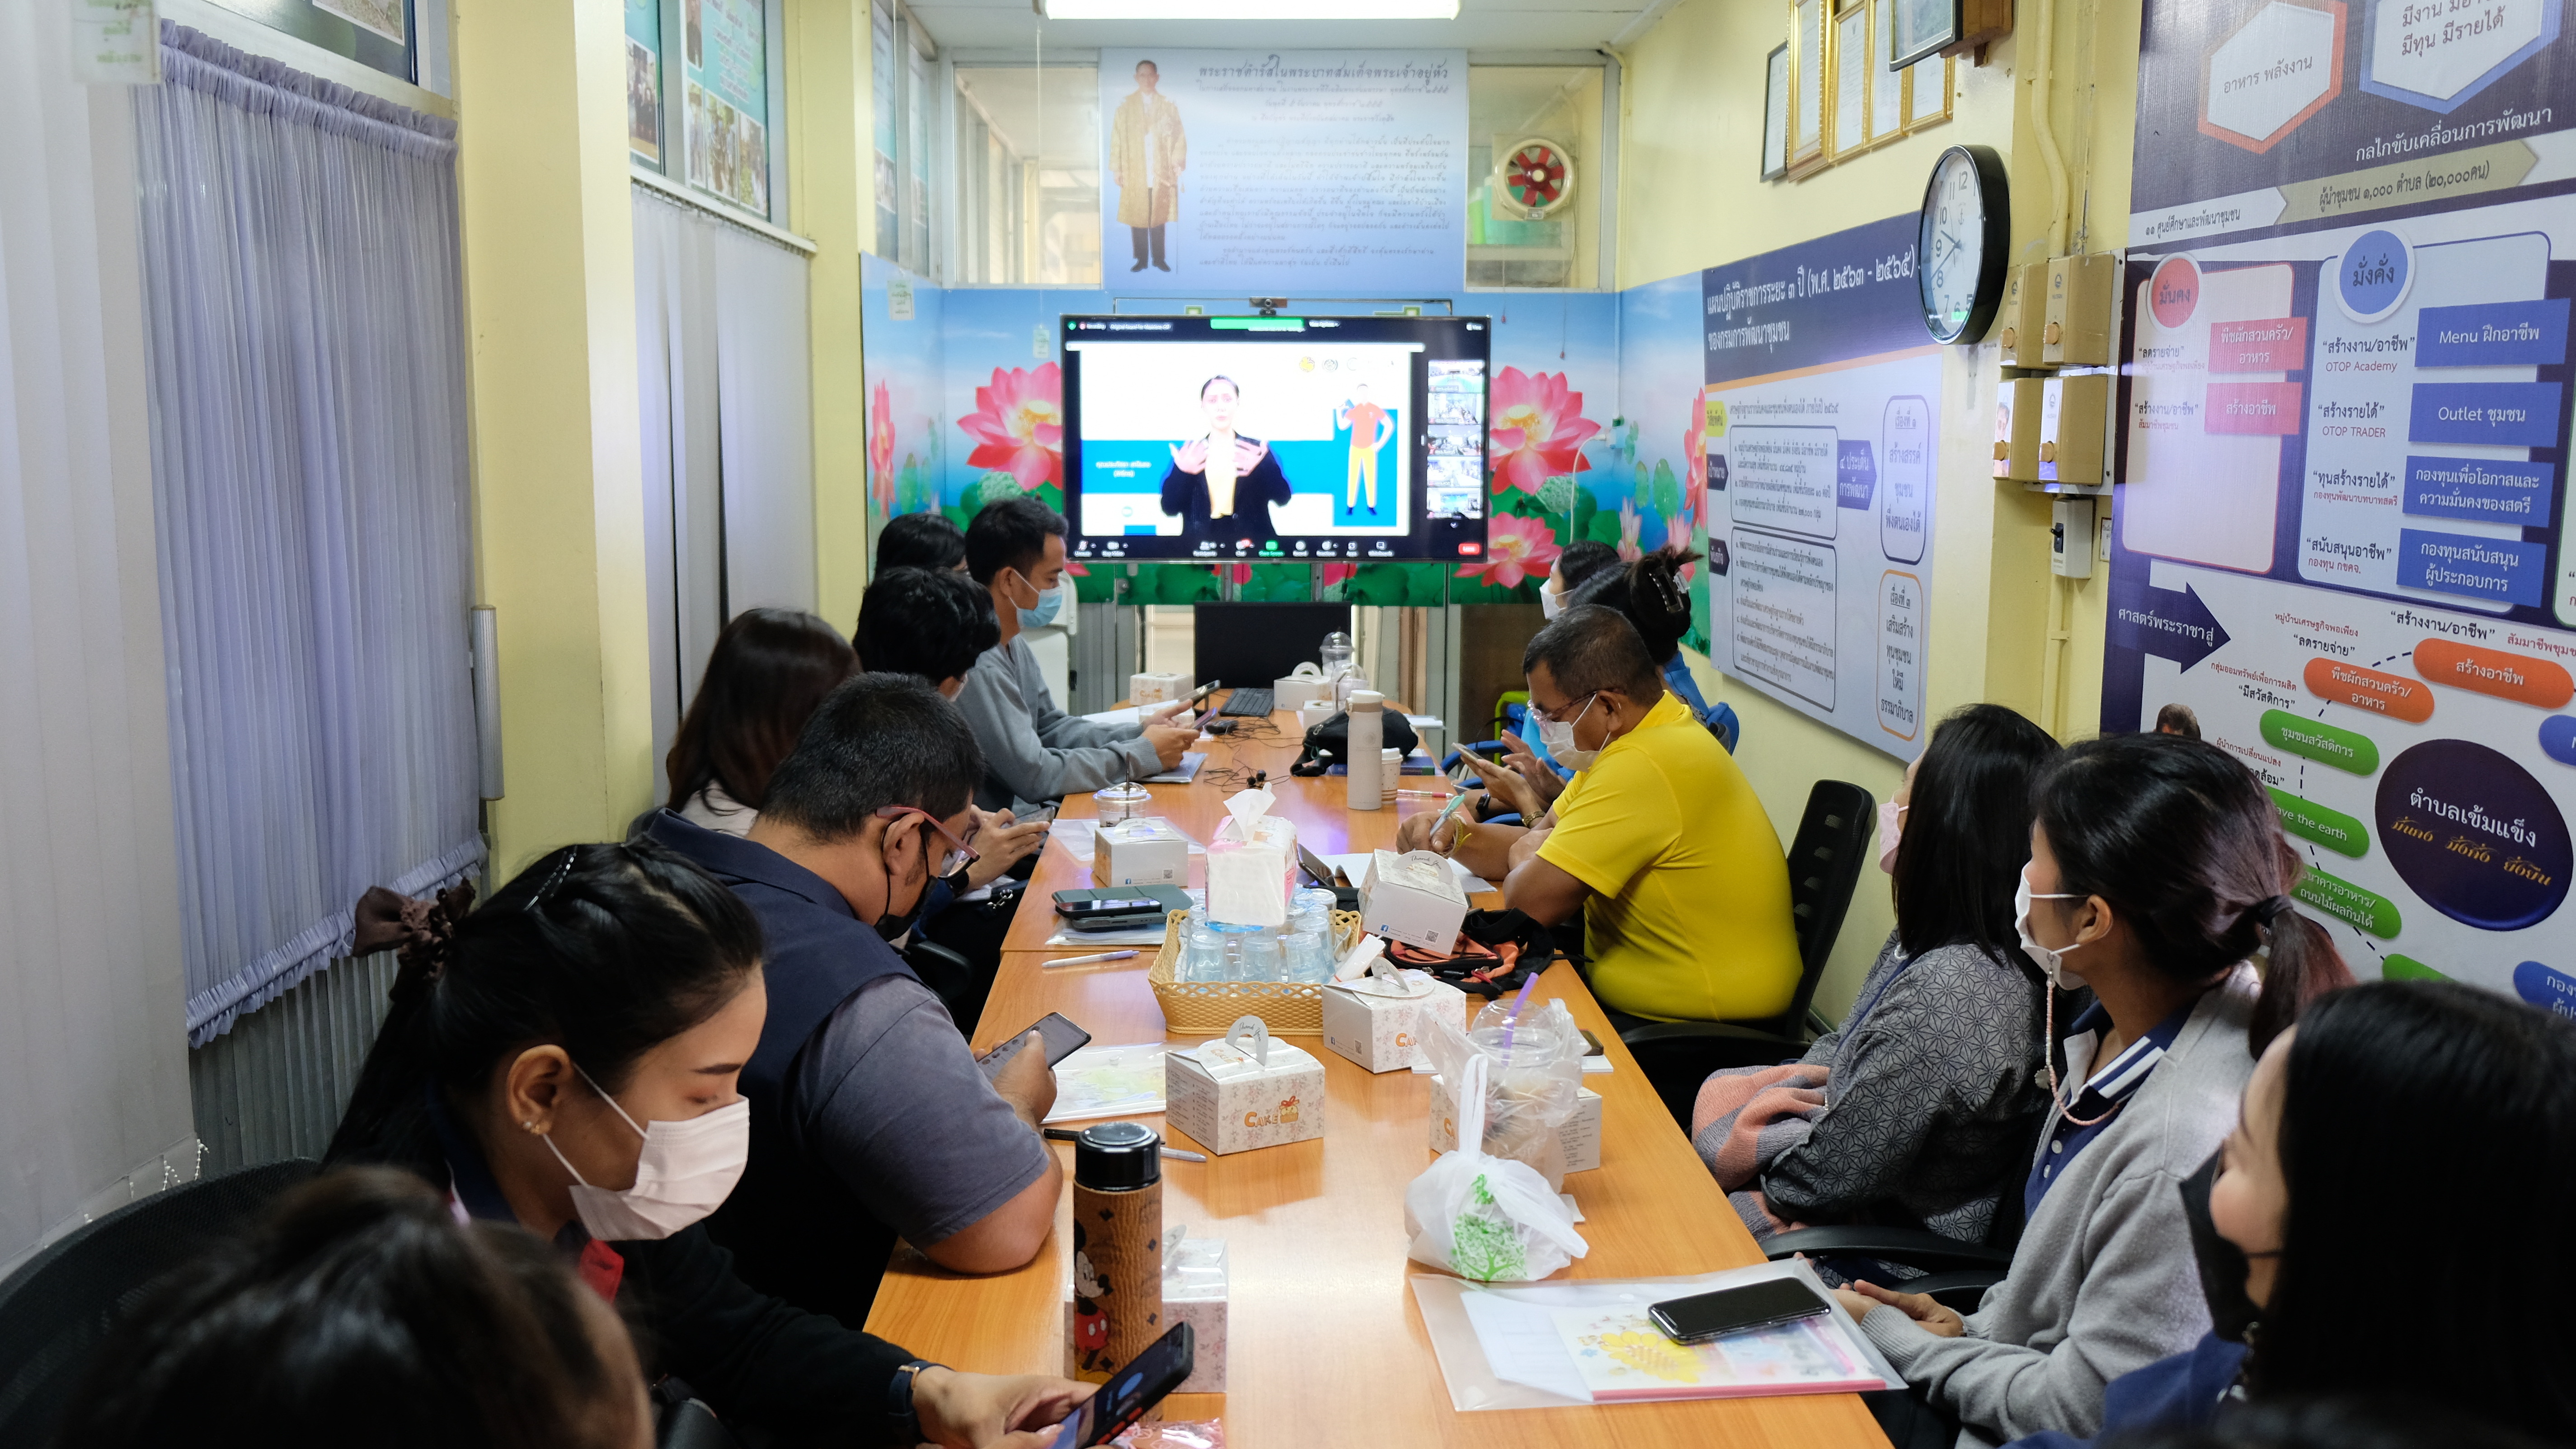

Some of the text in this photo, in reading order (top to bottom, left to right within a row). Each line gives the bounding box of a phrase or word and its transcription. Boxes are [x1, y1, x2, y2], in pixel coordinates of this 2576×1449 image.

[2402, 3, 2442, 28] มีงาน
[2402, 5, 2505, 57] มีทุน มีรายได้
[2223, 55, 2313, 94] อาหาร พลังงาน
[2355, 107, 2552, 161] กลไกขับเคลื่อนการพัฒนา
[1948, 182, 1955, 200] 11
[1958, 170, 1968, 191] 12
[2319, 184, 2360, 216] ผู้นำชุมชน
[2396, 170, 2424, 193] ตำบล
[1939, 206, 1947, 225] 10
[2157, 207, 2241, 239] ศูนย์ศึกษาและพัฒนาชุมชน
[1935, 239, 1942, 258] 9
[1936, 271, 1943, 288] 8
[2352, 254, 2395, 287] มั่งคั่ง
[1707, 280, 1786, 320] แผนปฏิบัติราชการระยะ
[1788, 284, 1795, 298] ๓
[1797, 264, 1804, 298] ปี
[1807, 267, 1829, 298] (พ.ศ.
[1944, 294, 1950, 313] 7
[2159, 282, 2191, 305] มั่นคง
[1708, 317, 1790, 353] ของกรมการพัฒนาชุมชน
[2221, 324, 2294, 343] พืชผักสวนครัว/
[2322, 335, 2415, 355] “สร้างงาน/อาชีพ”
[2439, 322, 2539, 345] Menu ฝึกอาชีพ
[2239, 352, 2270, 364] อาหาร
[2326, 361, 2397, 375] OTOP Academy
[2226, 398, 2276, 415] สร้างอาชีพ
[2318, 402, 2385, 420] “สร้างรายได้”
[2438, 406, 2526, 428] Outlet ชุมชน
[2322, 426, 2386, 438] OTOP TRADER
[1846, 448, 1869, 471] ประเด็น
[1889, 442, 1920, 465] สร้างสรรค์
[1839, 478, 1869, 499] การพัฒนา
[2313, 468, 2396, 491] “ทุนสร้างรายได้”
[2416, 465, 2539, 490] กองทุนเพื่อโอกาสและ
[1894, 482, 1913, 504] ชุมชน
[2313, 489, 2398, 508] กองทุนพัฒนาบทบาทสตรี
[2419, 491, 2531, 514] ความมั่นคงของสตรี
[1885, 509, 1921, 532] พึ่งตนเองได้
[2306, 536, 2392, 562] “สนับสนุนอาชีพ”
[2421, 541, 2519, 569] กองทุนสนับสนุน
[2308, 555, 2361, 576] กองทุน กขคจ.
[2425, 565, 2508, 592] ผู้ประกอบการ
[1886, 616, 1913, 639] เสริมสร้าง
[2275, 612, 2359, 637] หมู่บ้านเศรษฐกิจพอเพียง
[2390, 610, 2496, 642] “สร้างงาน/อาชีพ”
[1886, 643, 1912, 666] ทุนชุมชน
[2294, 634, 2355, 656] “ลดรายจ่าย”
[2507, 633, 2576, 658] สัมมาชีพชุมช
[1892, 669, 1904, 692] ให้มี
[2211, 662, 2297, 692] กลุ่มออมทรัพย์เพื่อการผลิต
[2331, 665, 2411, 699] พืชผักสวนครัว/
[2456, 658, 2524, 686] สร้างอาชีพ
[2238, 685, 2295, 709] “มีสวัสดิการ”
[2351, 691, 2386, 713] อาหาร
[1880, 698, 1913, 724] ธรรมาภิบาล
[2216, 737, 2282, 767] ผู้นำการเปลี่ยนแปลง
[2281, 727, 2354, 758] ชุมชนสวัสดิการ
[2276, 806, 2347, 841] ave the earth
[2410, 787, 2537, 848] ตำบลเข้มแข็ง
[1410, 854, 1443, 870] Thank You
[2300, 888, 2374, 929] ถนนไม้ผลกินได้
[1238, 1021, 1262, 1042] Thank You
[1244, 1110, 1279, 1128] CAKE
